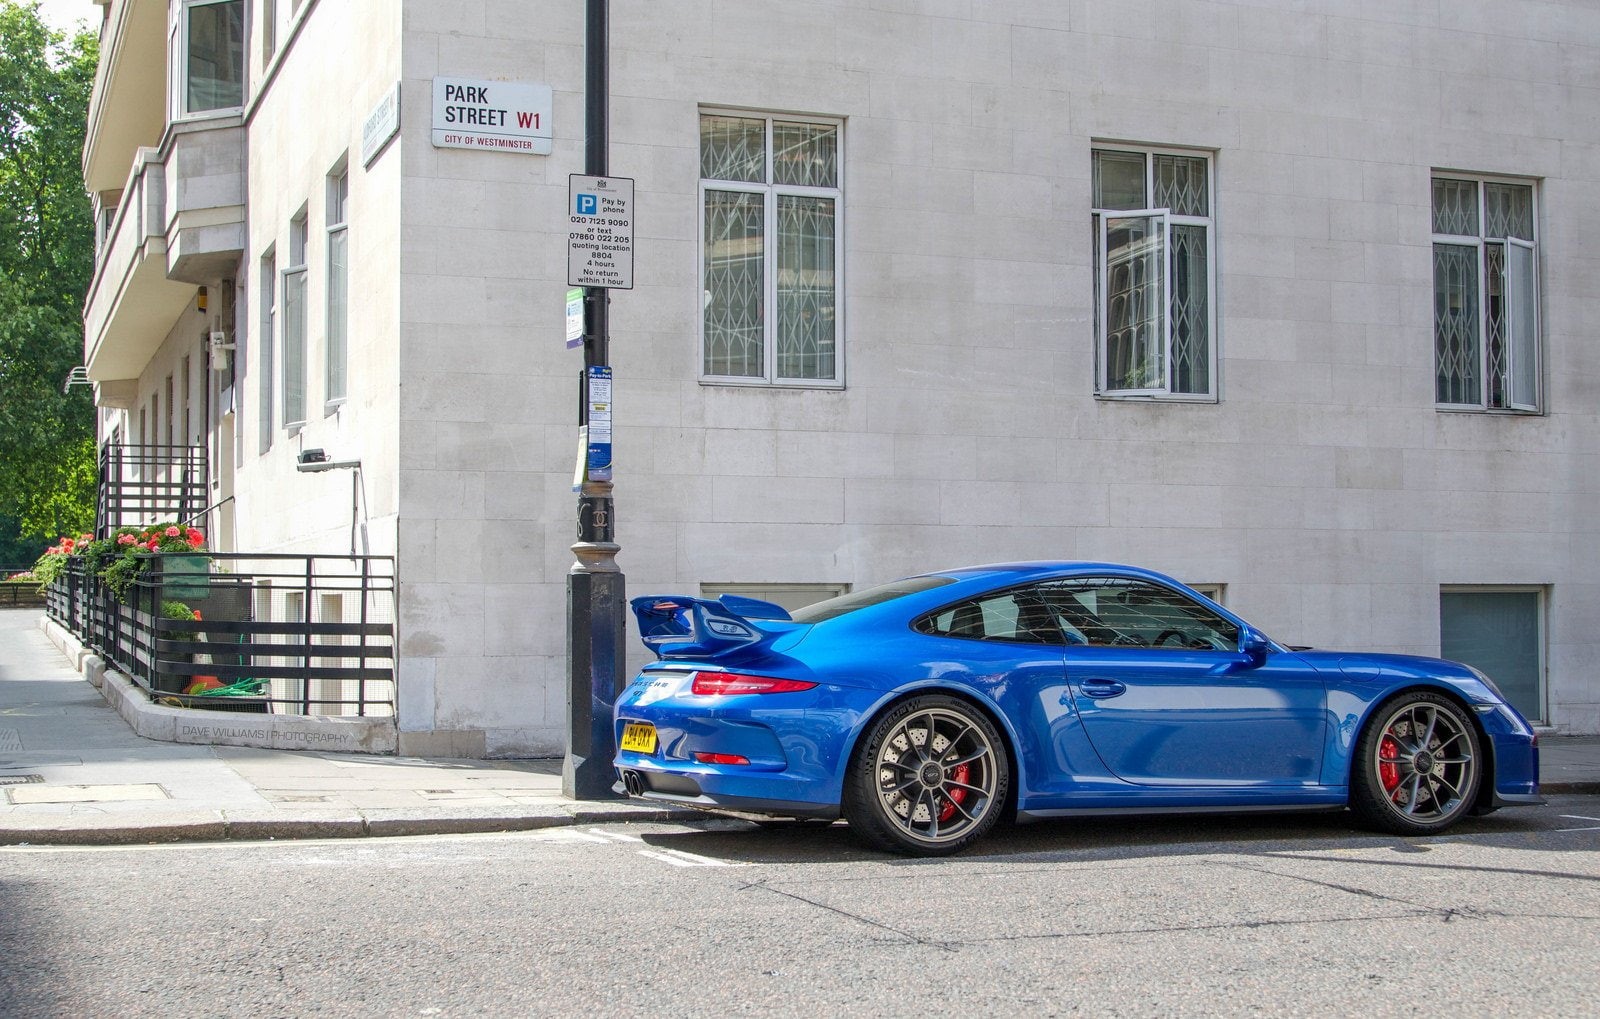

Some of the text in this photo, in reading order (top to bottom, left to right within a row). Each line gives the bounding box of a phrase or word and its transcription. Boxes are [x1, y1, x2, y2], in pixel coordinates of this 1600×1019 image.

[445, 84, 488, 104] PARK
[445, 106, 540, 130] STREET W1
[444, 134, 532, 150] CITY OF WESTMINSTER
[582, 196, 626, 213] P Pay by
[602, 206, 625, 214] phone
[570, 216, 629, 227] 020 7125 9090
[569, 232, 595, 240] 07860
[601, 244, 631, 252] location
[594, 260, 615, 268] hours
[607, 278, 624, 286] hour
[872, 705, 909, 748] MICHELIN
